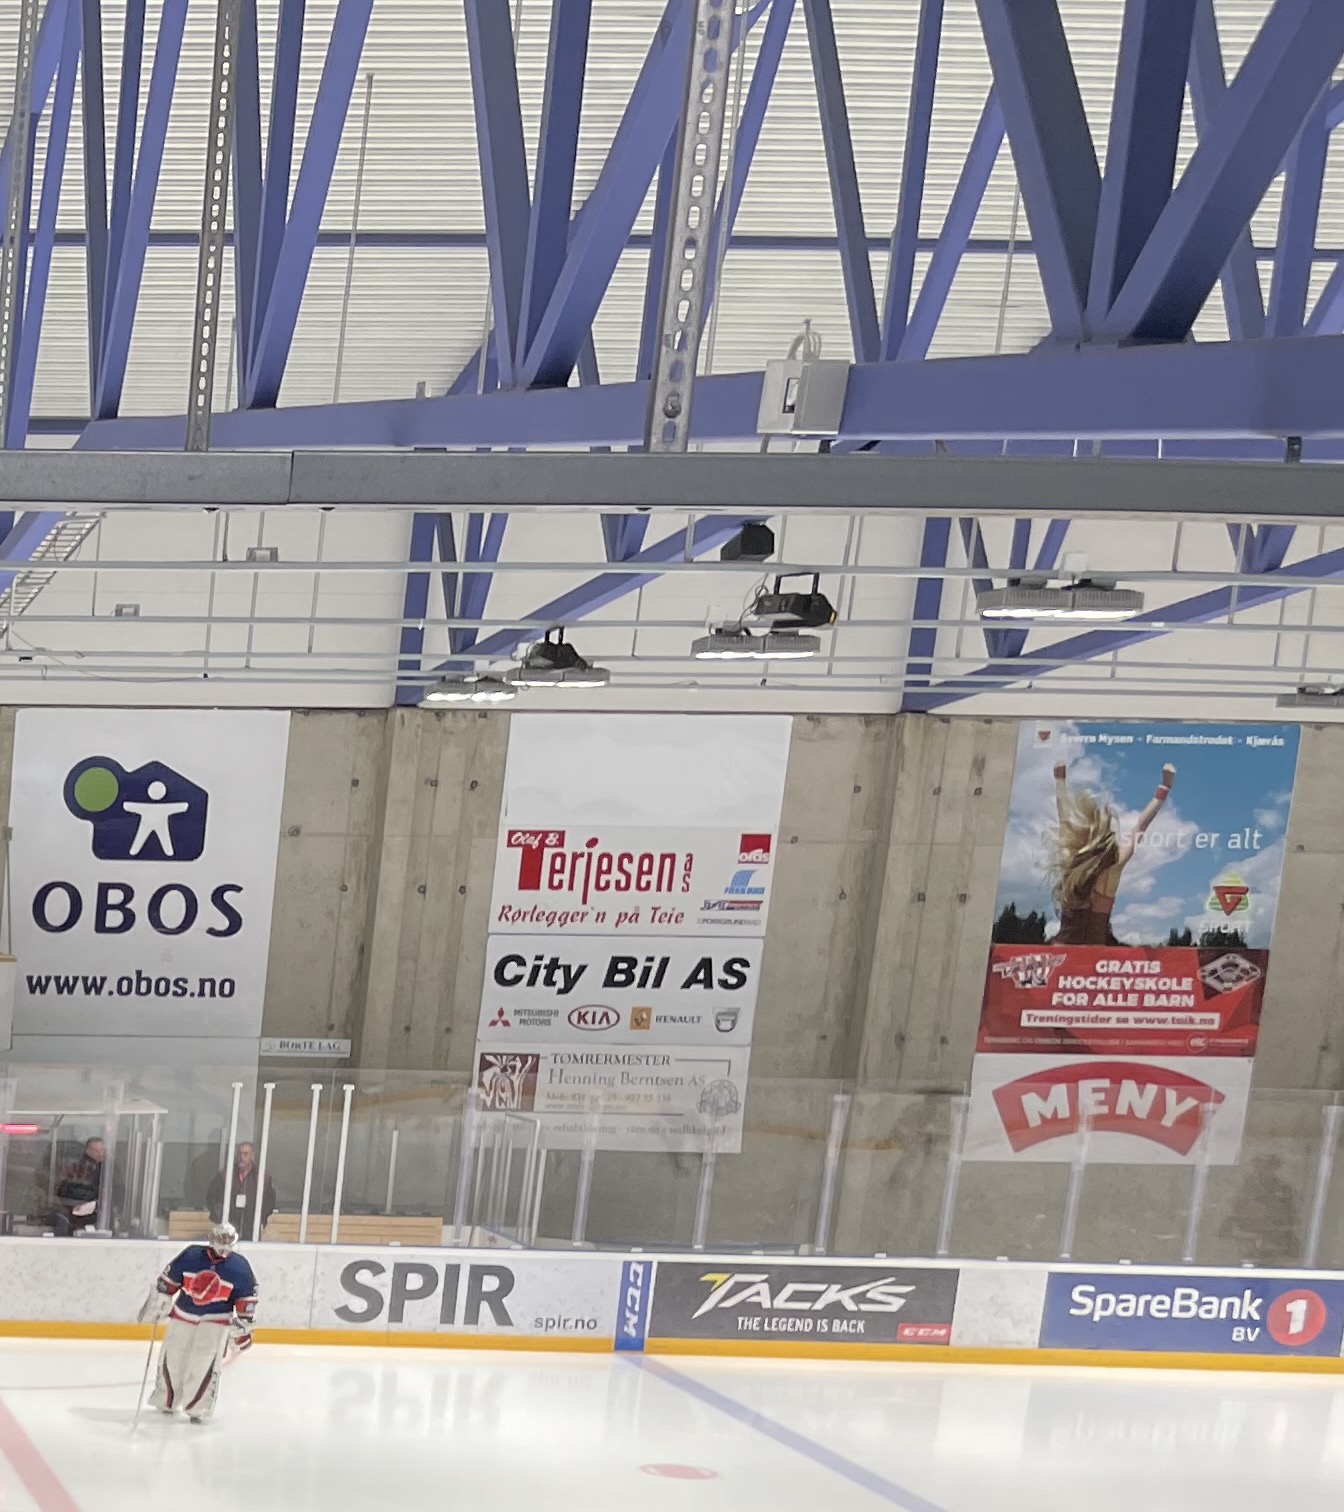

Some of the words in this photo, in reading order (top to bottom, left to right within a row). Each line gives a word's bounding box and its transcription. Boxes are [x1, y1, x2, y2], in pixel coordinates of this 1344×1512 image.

[511, 832, 541, 848] Olaf
[1117, 829, 1190, 856] sport
[1195, 829, 1219, 848] er
[1228, 828, 1262, 851] alt
[507, 830, 676, 905] Terjesen
[31, 880, 243, 938] OBOS
[615, 905, 640, 928] på
[650, 906, 685, 924] Teie
[493, 954, 588, 995] City
[602, 956, 670, 989] Bil
[680, 957, 751, 991] AS
[1095, 960, 1161, 974] GRATIS
[26, 969, 236, 998] www.obos.no
[1058, 976, 1193, 991] HOCKEYSKOLE
[1052, 992, 1088, 1006] FOR
[1093, 993, 1138, 1006] ALLE
[1143, 994, 1195, 1007] BARN
[576, 1010, 611, 1025] KIA
[655, 1015, 703, 1024] RENAULT
[548, 1068, 615, 1087] Henning
[1020, 1078, 1200, 1128] MENY
[334, 1260, 516, 1327] SPIR
[624, 1262, 644, 1338] CCM
[692, 1273, 916, 1319] TACKS
[1069, 1284, 1264, 1322] SpareBank
[1286, 1299, 1307, 1335] 1
[534, 1313, 598, 1333] spir.no
[737, 1316, 761, 1330] THE
[764, 1317, 812, 1332] LEGEND
[817, 1319, 828, 1332] IS
[832, 1319, 865, 1333] BACK
[902, 1327, 947, 1336] CCM
[1231, 1326, 1260, 1342] BV
